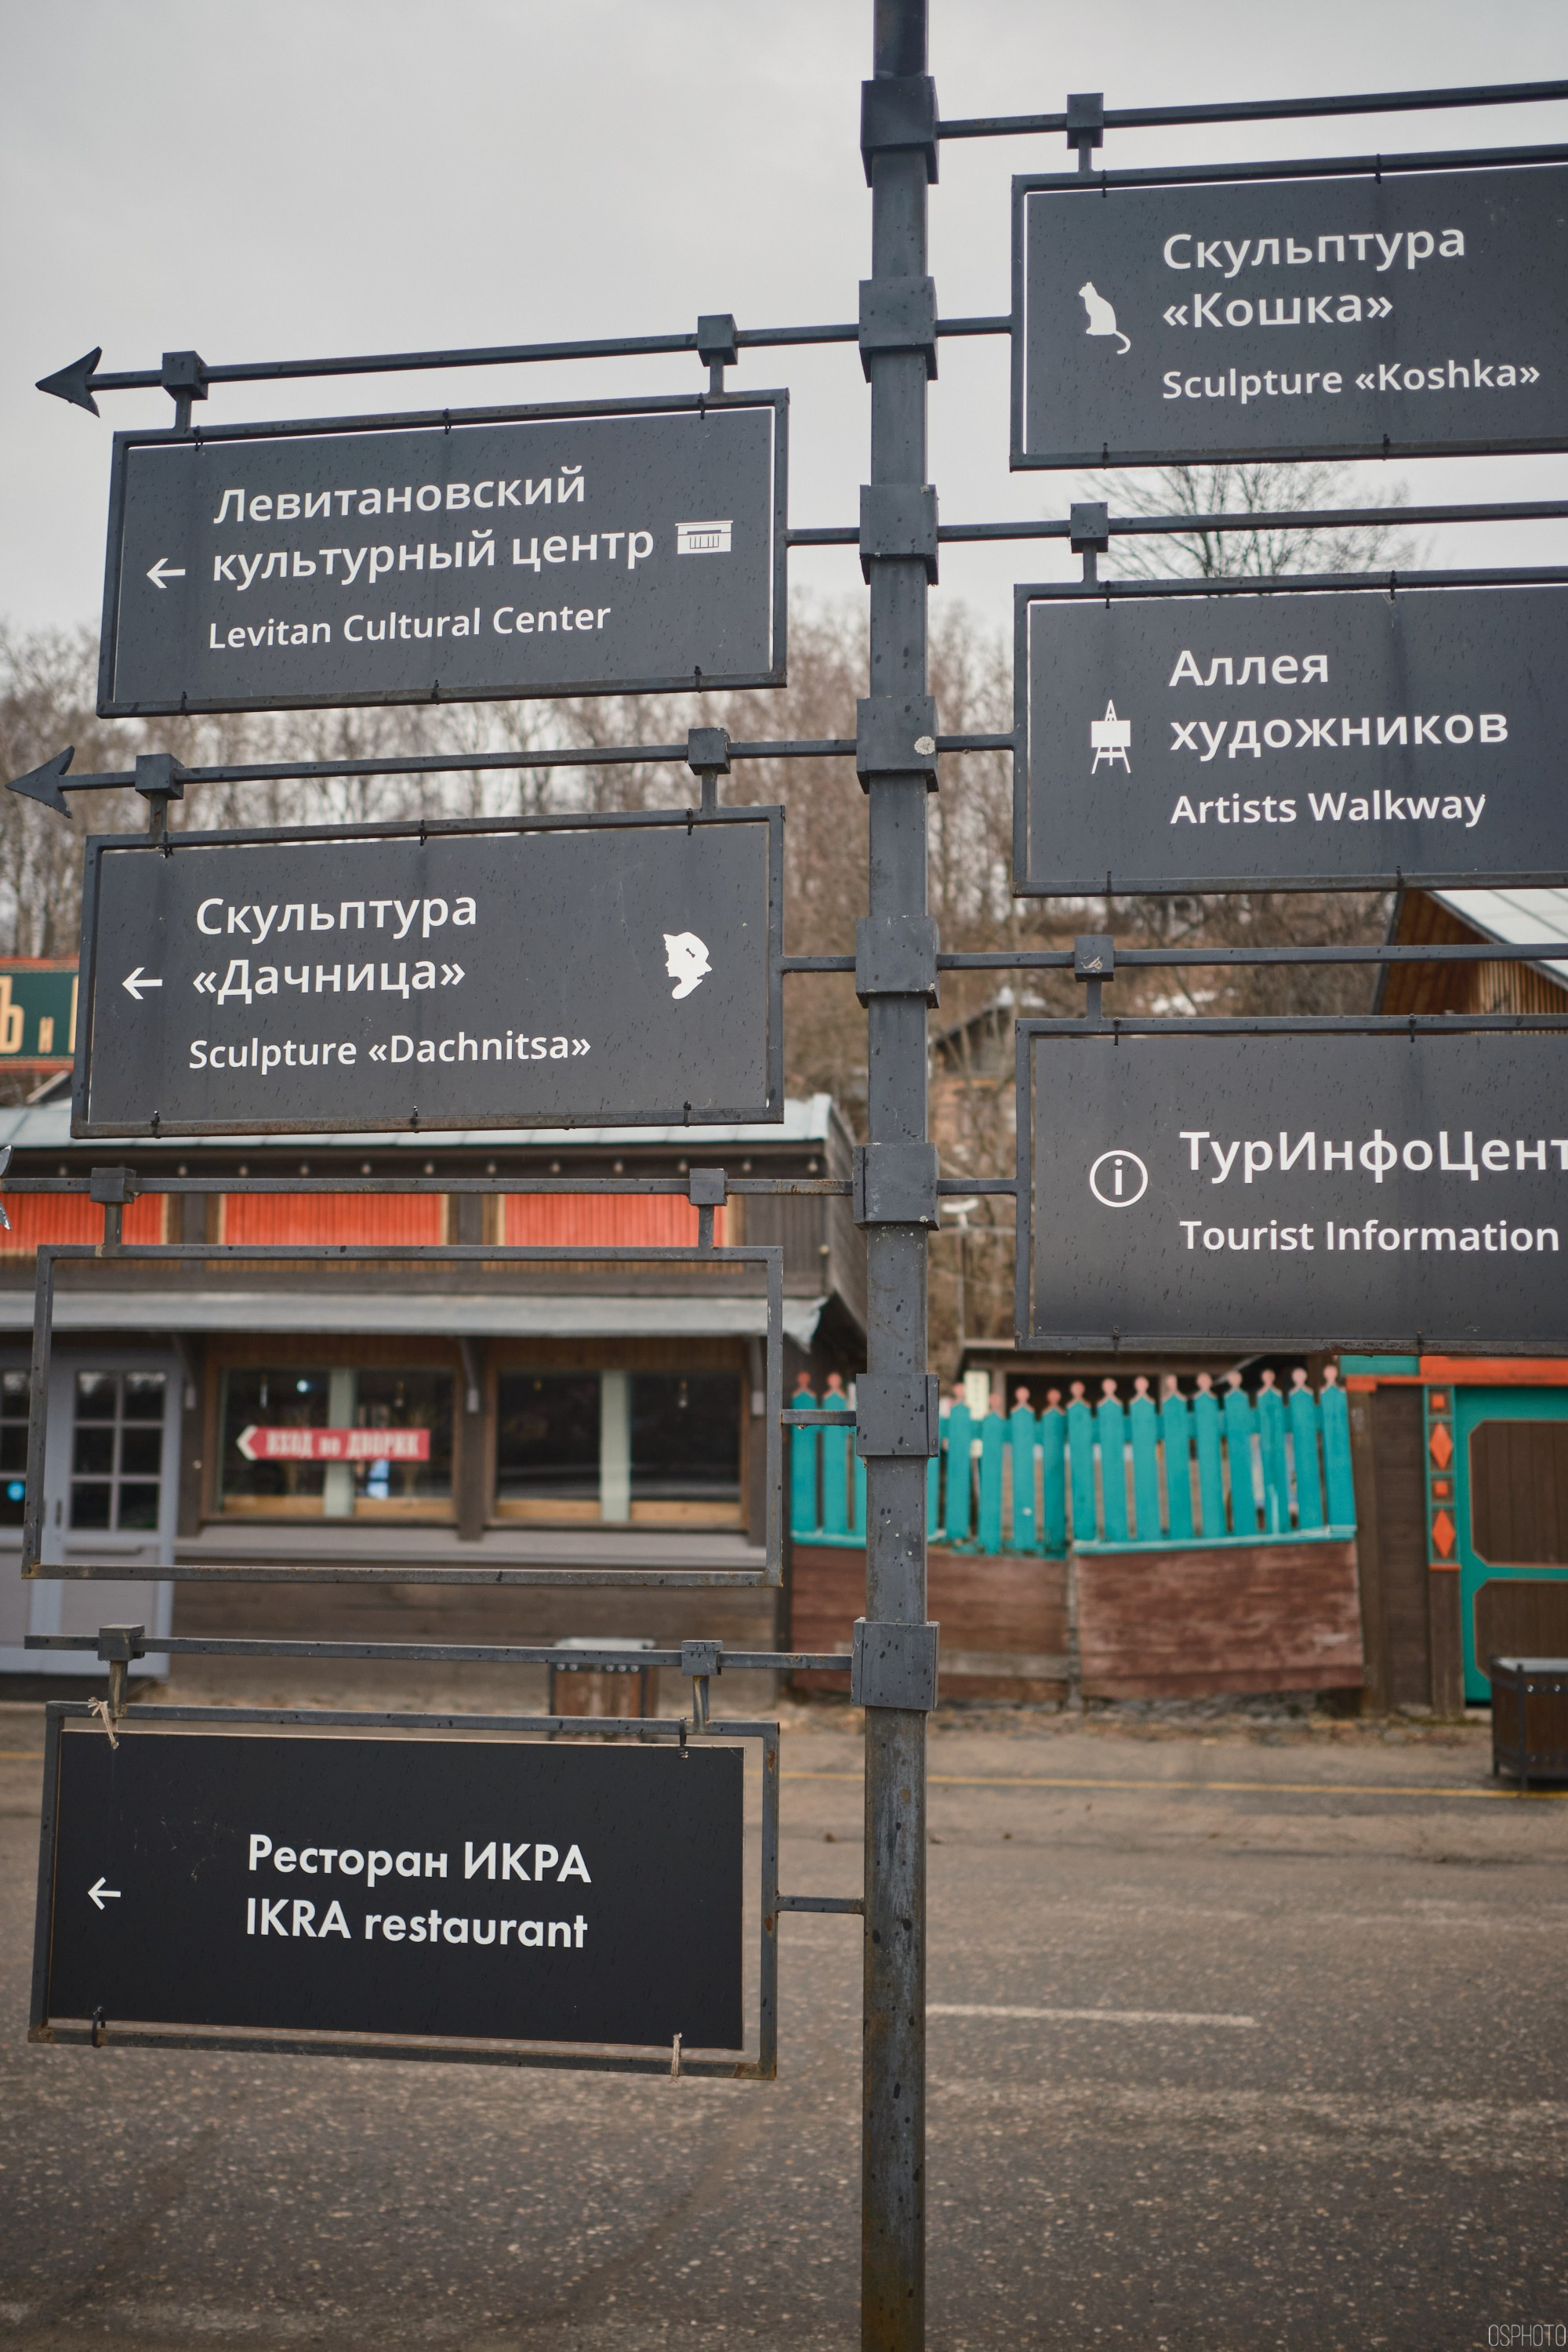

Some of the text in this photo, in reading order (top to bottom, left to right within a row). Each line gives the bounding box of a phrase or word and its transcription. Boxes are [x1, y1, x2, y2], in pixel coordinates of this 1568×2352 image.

[1163, 229, 1465, 278] Скульптура
[1163, 292, 1393, 328] «Кошка»
[1163, 358, 1541, 405] Sculpture «Koshka»
[213, 465, 585, 524] Левитановский
[213, 528, 654, 591] культурный центр
[209, 605, 612, 649] Levitan Cultural Center
[1168, 650, 1329, 687] Аллея
[1170, 713, 1508, 762] художников
[1170, 789, 1486, 828] Artists Walkway
[196, 896, 477, 945] Скульптура
[192, 959, 466, 1006] «Дачница»
[189, 1029, 591, 1076] Sculpture «Dachnitsa»
[1179, 1219, 1559, 1251] Tourist Information
[249, 1834, 592, 1888] Ресторан ИКРА
[247, 1897, 588, 1948] IKRA restaurant
